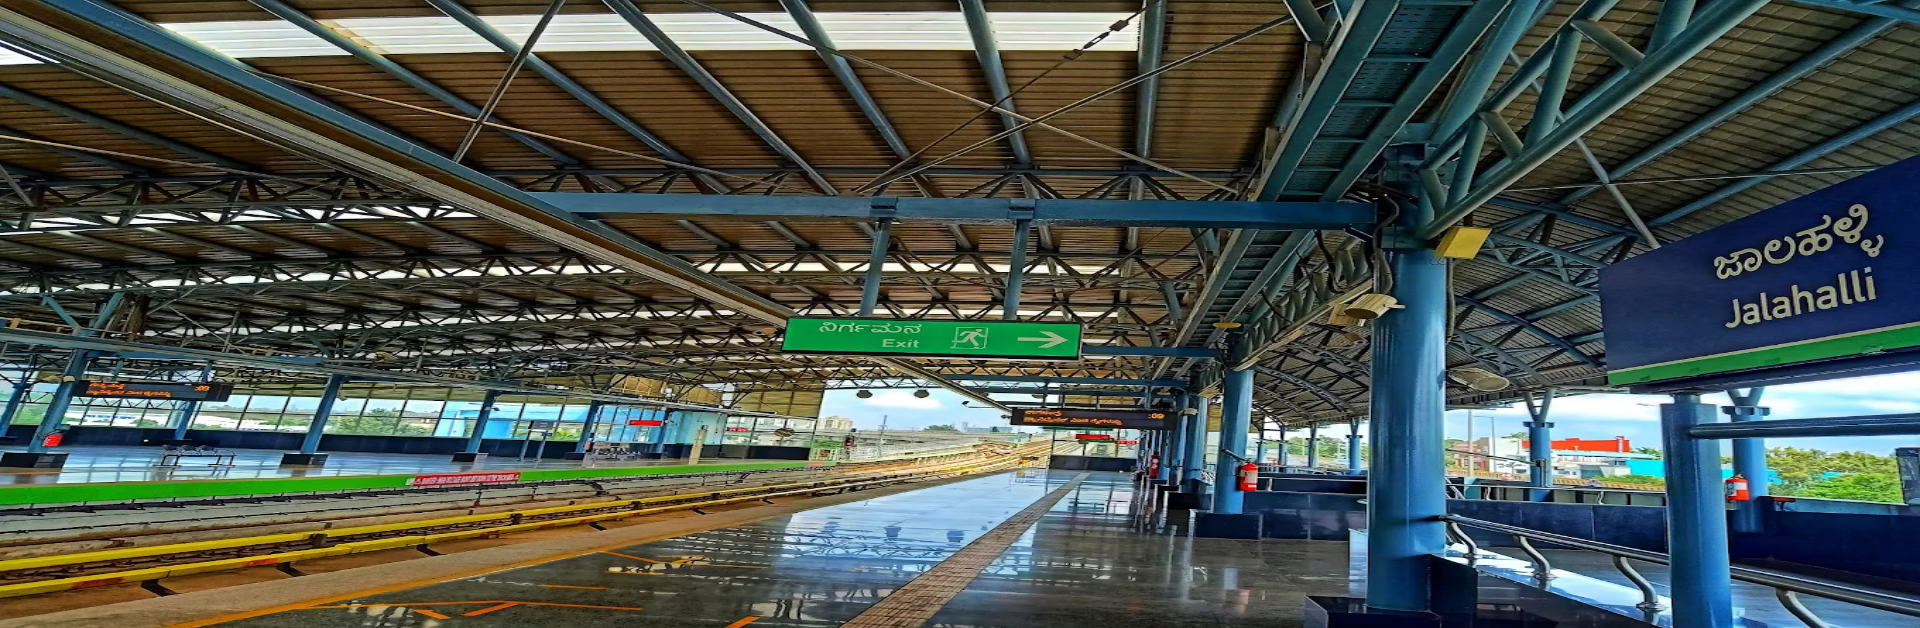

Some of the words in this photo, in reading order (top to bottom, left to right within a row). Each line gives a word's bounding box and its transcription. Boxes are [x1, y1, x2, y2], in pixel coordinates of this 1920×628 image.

[1714, 204, 1884, 279] ಜಾಲಹಳ್ಳಿ
[1725, 267, 1876, 328] Jalahalli
[819, 322, 922, 334] ನಿರ್ಗಮನ
[882, 339, 919, 348] Exit
